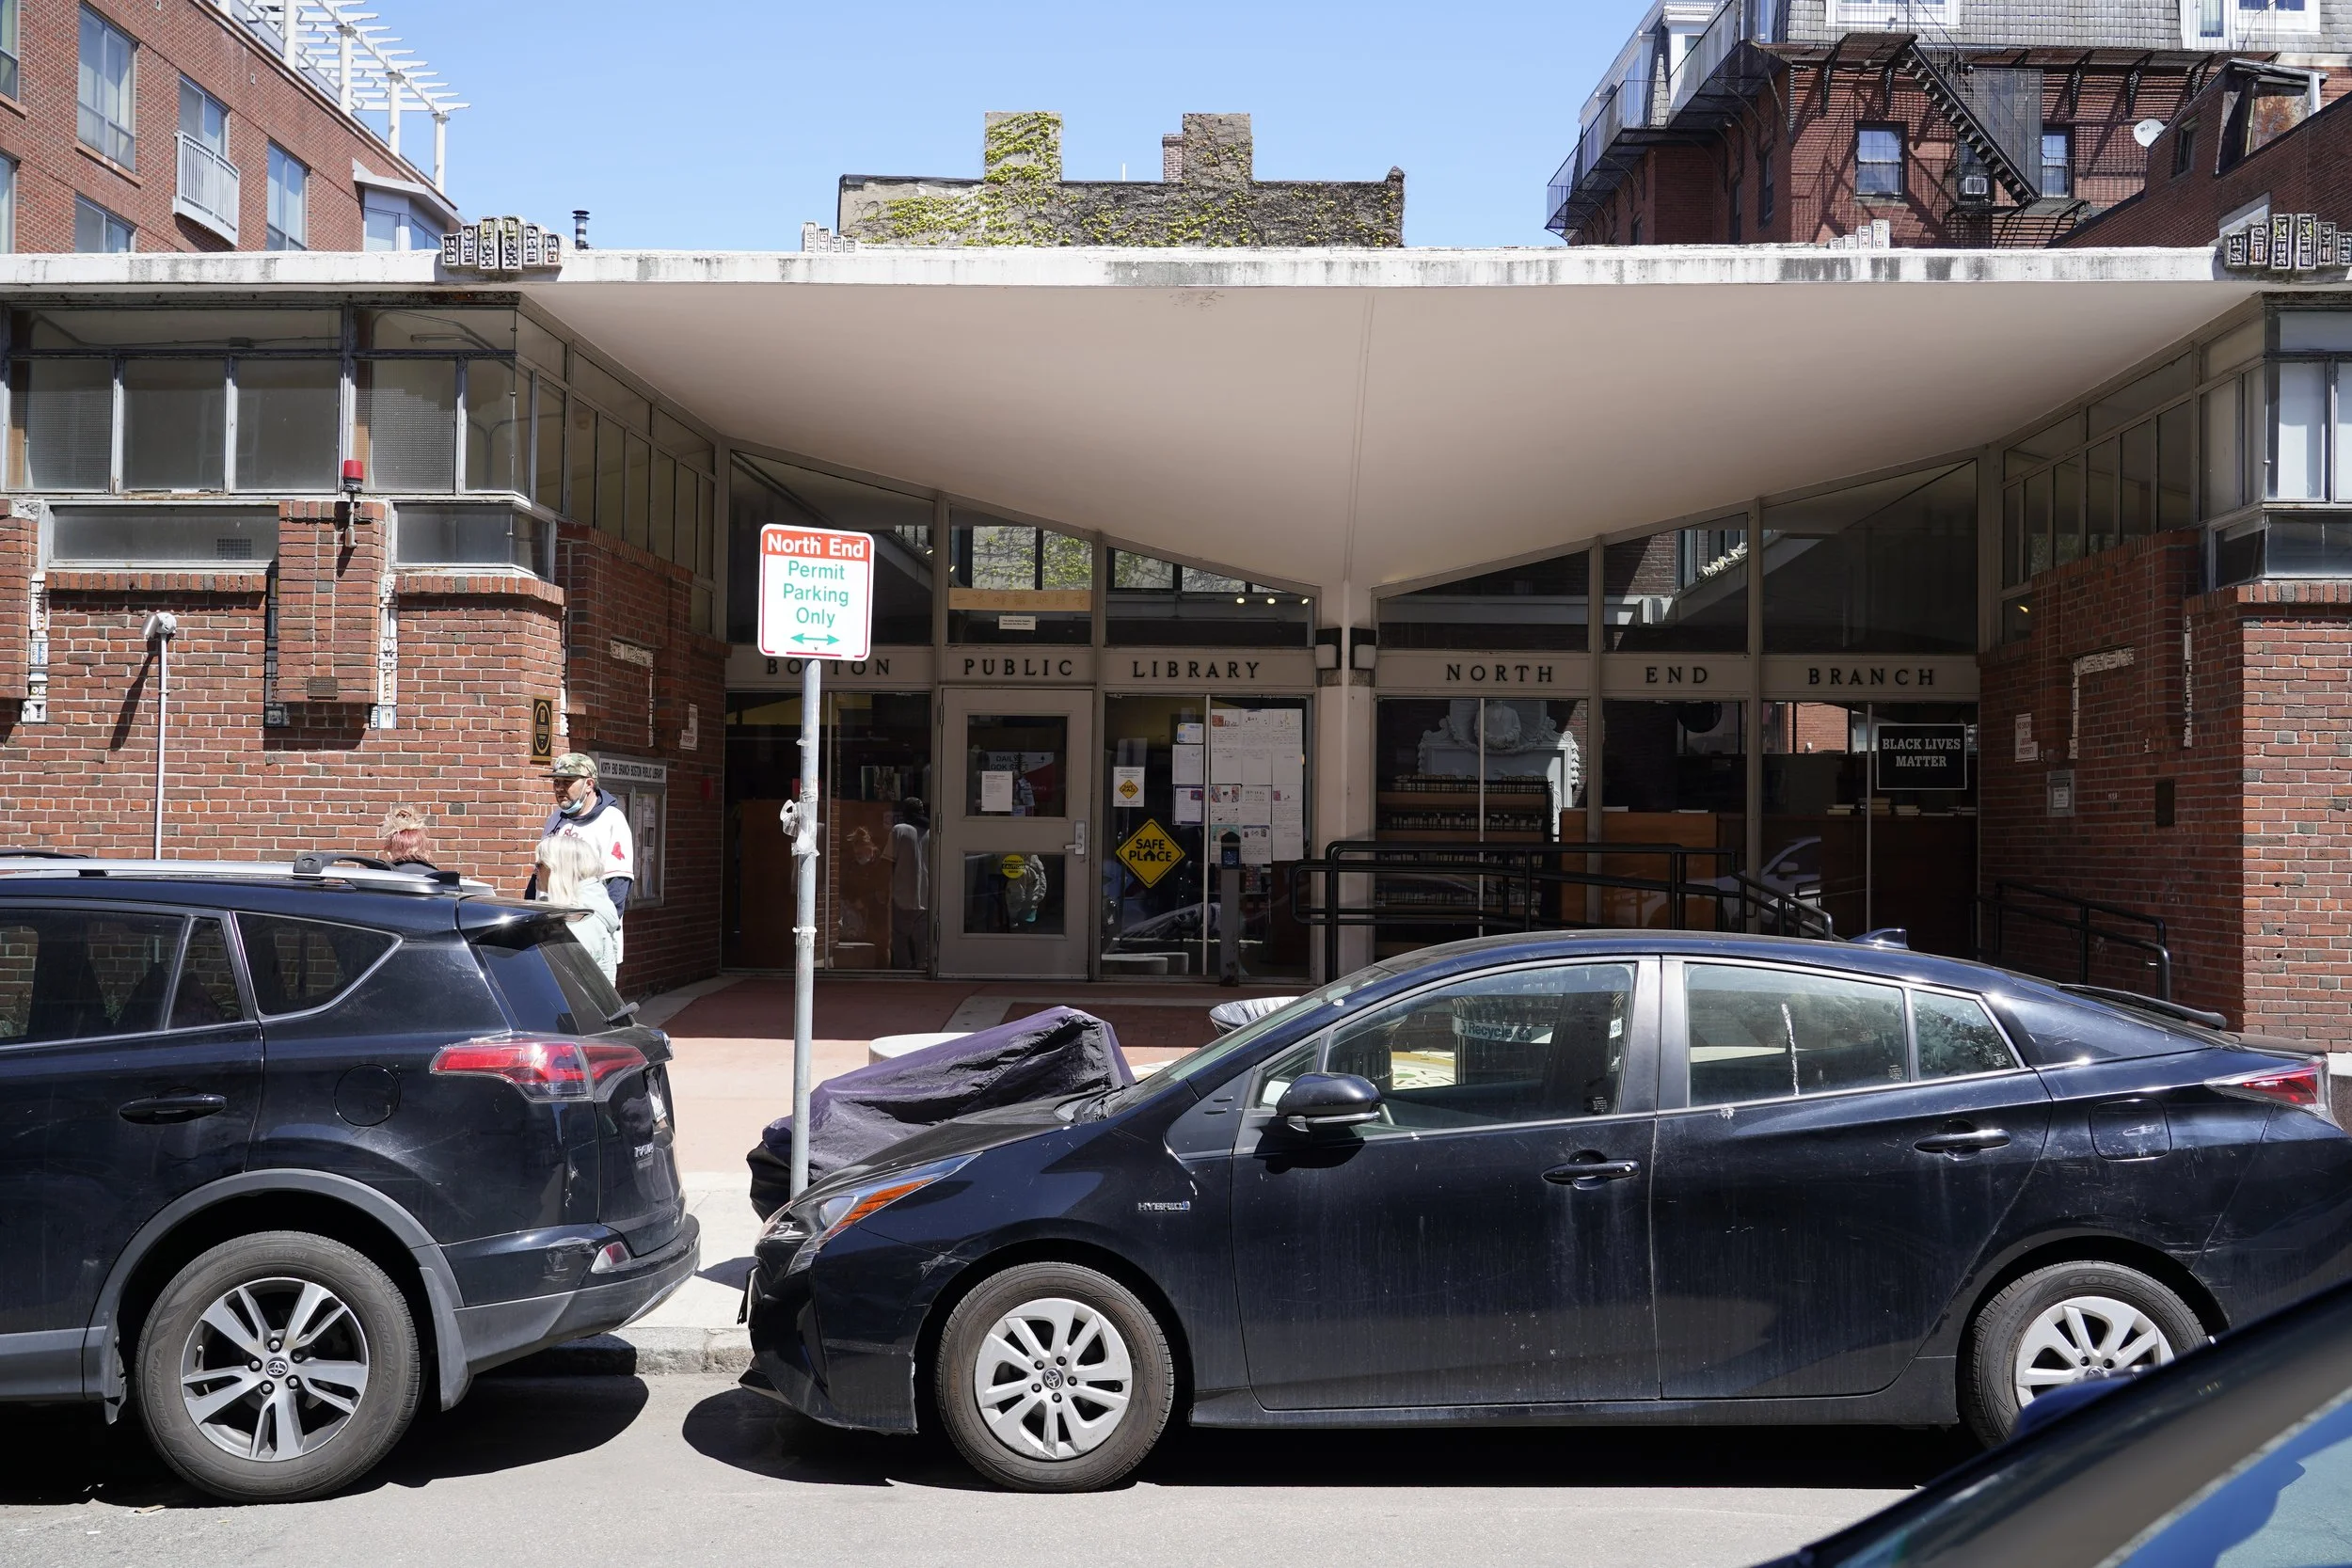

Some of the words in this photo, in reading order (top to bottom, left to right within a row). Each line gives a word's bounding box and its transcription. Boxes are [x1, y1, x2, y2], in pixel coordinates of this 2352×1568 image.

[767, 532, 821, 555] North
[829, 538, 865, 558] End
[788, 560, 845, 579] Permit
[783, 583, 850, 607] Parking
[796, 607, 835, 628] Only
[767, 658, 890, 675] BOTON
[963, 658, 1073, 676] PUBLIC
[1132, 661, 1260, 679] LIBRARY
[1446, 664, 1553, 683] NORTH
[1645, 666, 1708, 684] END
[1808, 668, 1934, 686] BRANCH
[1883, 738, 1921, 750] BLACK
[1925, 738, 1961, 750] LIVES
[2020, 738, 2032, 747] LIBRAR
[601, 762, 611, 774] NORTH
[618, 764, 630, 776] BRANCH
[630, 765, 643, 777] BOSTON
[643, 766, 652, 779] PUBLIC
[652, 768, 663, 779] LIBRARY
[1896, 756, 1947, 768] MATTER
[1136, 839, 1166, 850] SAFE
[1469, 1022, 1513, 1038] Recycle
[1137, 1202, 1183, 1212] HYBRID
